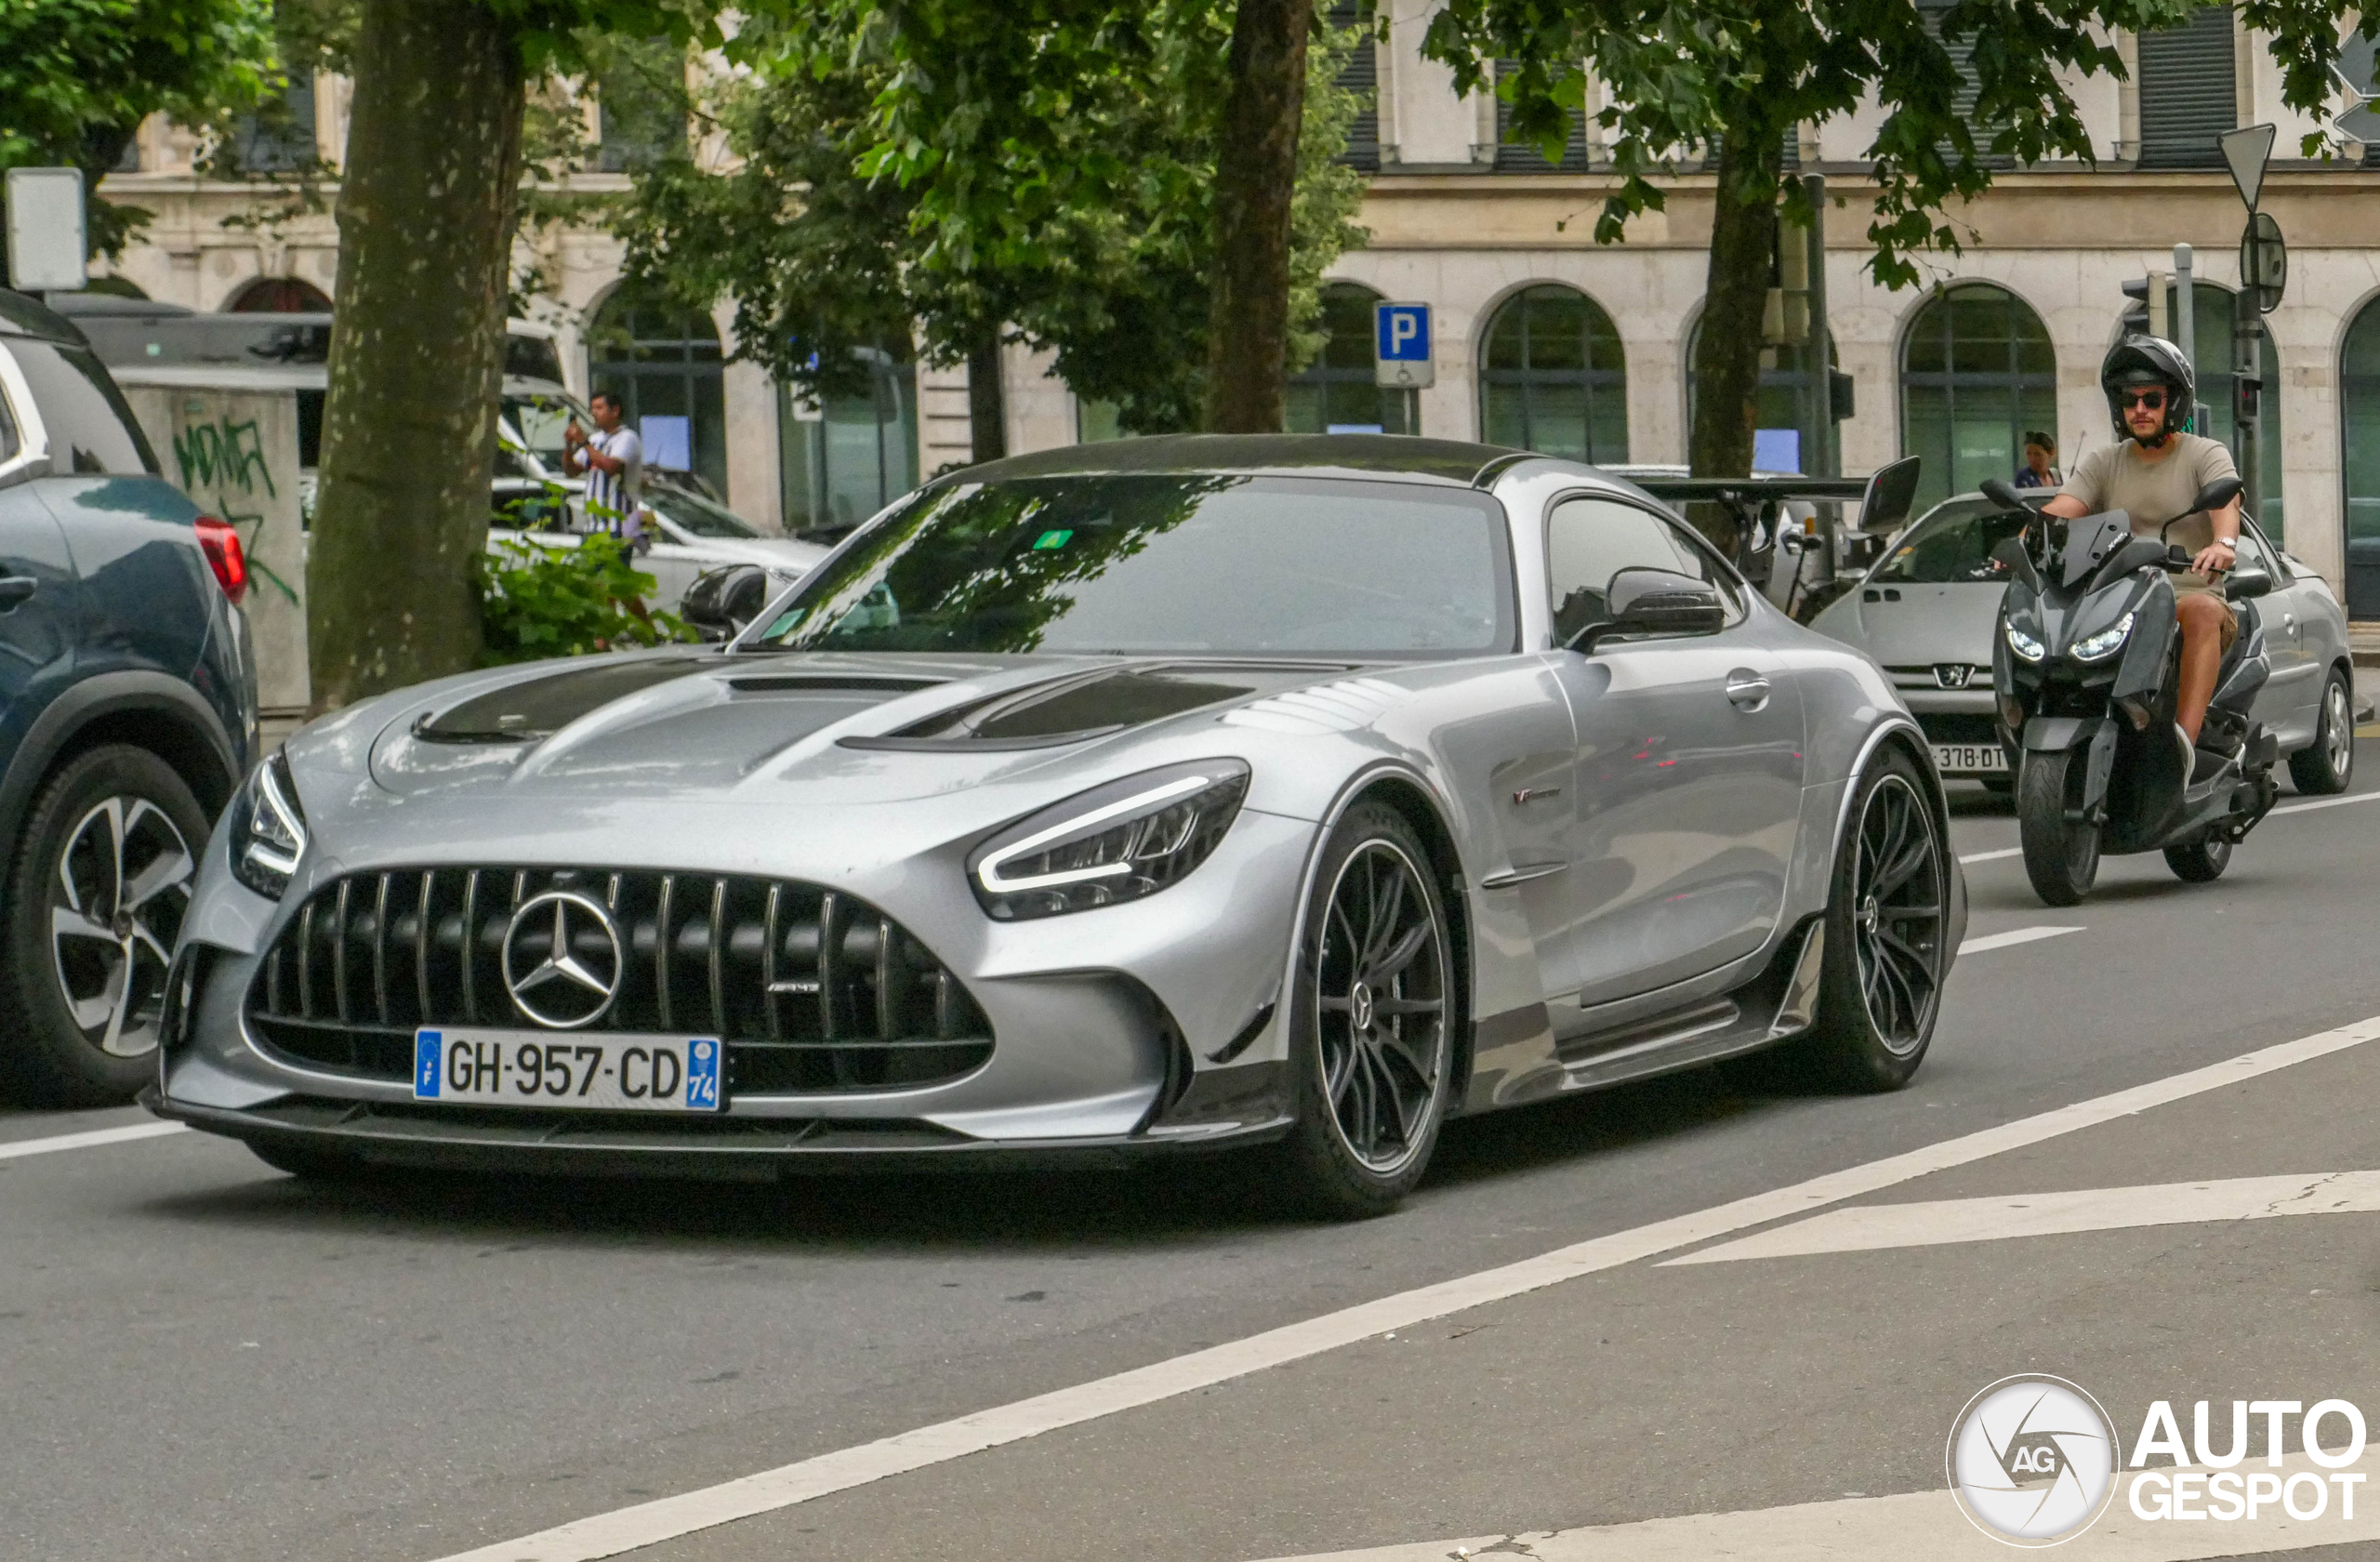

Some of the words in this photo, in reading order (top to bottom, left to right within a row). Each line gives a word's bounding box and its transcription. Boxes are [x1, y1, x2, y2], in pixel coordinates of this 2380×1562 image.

[1392, 312, 1417, 354] P
[423, 1070, 432, 1086] F
[448, 1040, 681, 1099] GH-957-CD
[689, 1075, 715, 1102] 74
